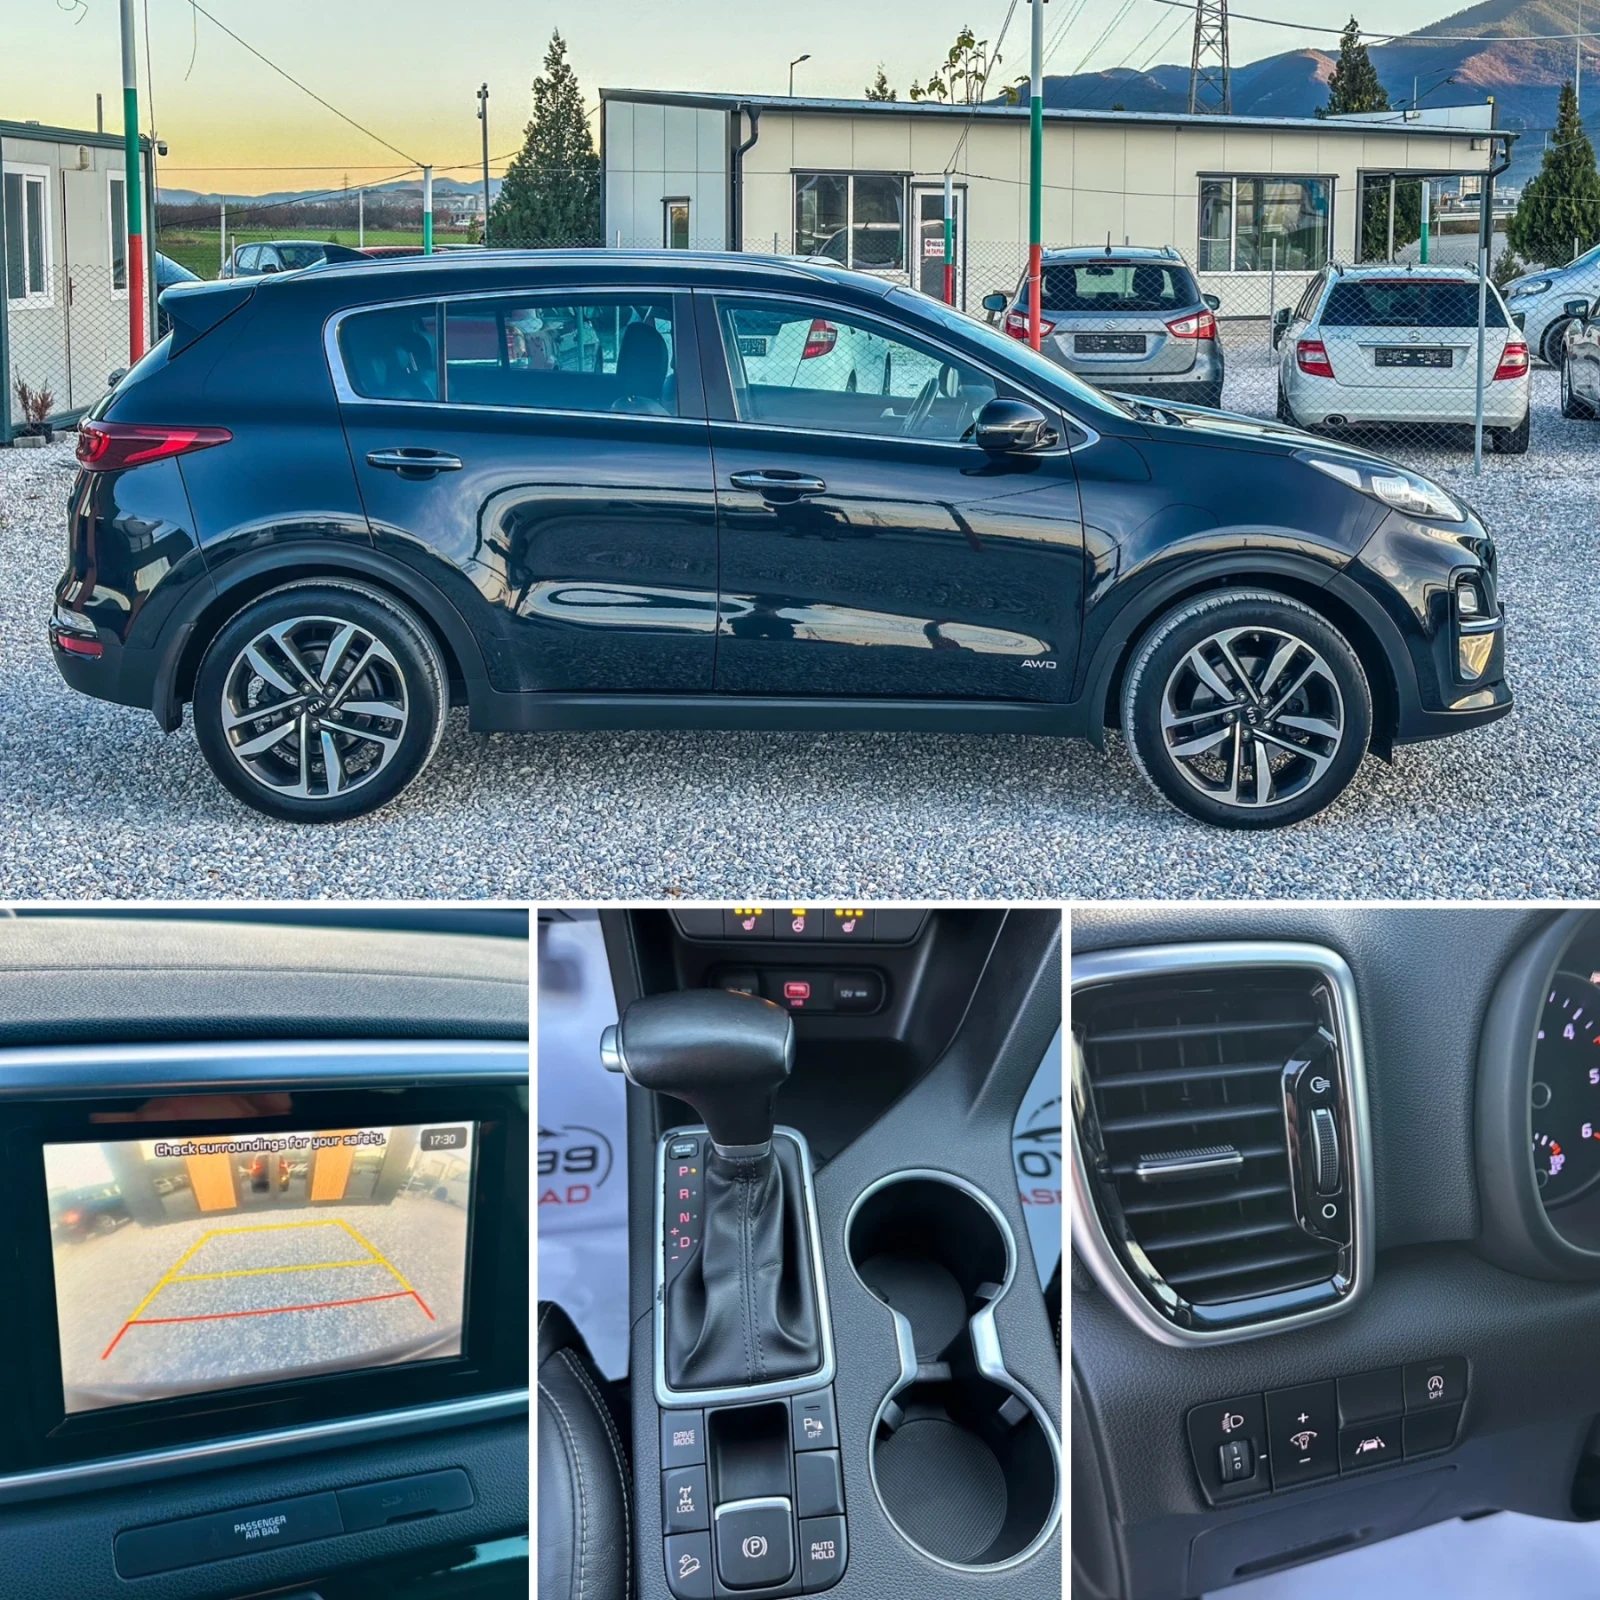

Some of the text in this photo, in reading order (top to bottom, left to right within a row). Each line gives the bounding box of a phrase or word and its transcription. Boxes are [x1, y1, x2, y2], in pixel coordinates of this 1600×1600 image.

[1021, 659, 1057, 669] AWD
[307, 700, 326, 713] KIA
[1246, 706, 1257, 724] KIA
[1563, 1023, 1575, 1040] 4
[1589, 1067, 1600, 1084] 5
[1582, 1122, 1592, 1138] 6
[155, 1131, 386, 1157] Check surroundings for your safety.
[429, 1134, 457, 1146] 17:30
[679, 1166, 689, 1176] P
[679, 1188, 689, 1200] R
[680, 1212, 690, 1223] N
[680, 1237, 691, 1248] D
[1429, 1390, 1444, 1399] OFF
[673, 1430, 695, 1439] DRIVE
[808, 1431, 822, 1439] OFF
[673, 1437, 695, 1446] MODE
[676, 1504, 695, 1513] LOCK
[233, 1515, 287, 1534] PASSENGER
[245, 1525, 280, 1540] AIR BAG
[811, 1540, 834, 1551] AUTO
[811, 1550, 835, 1560] HOLD
